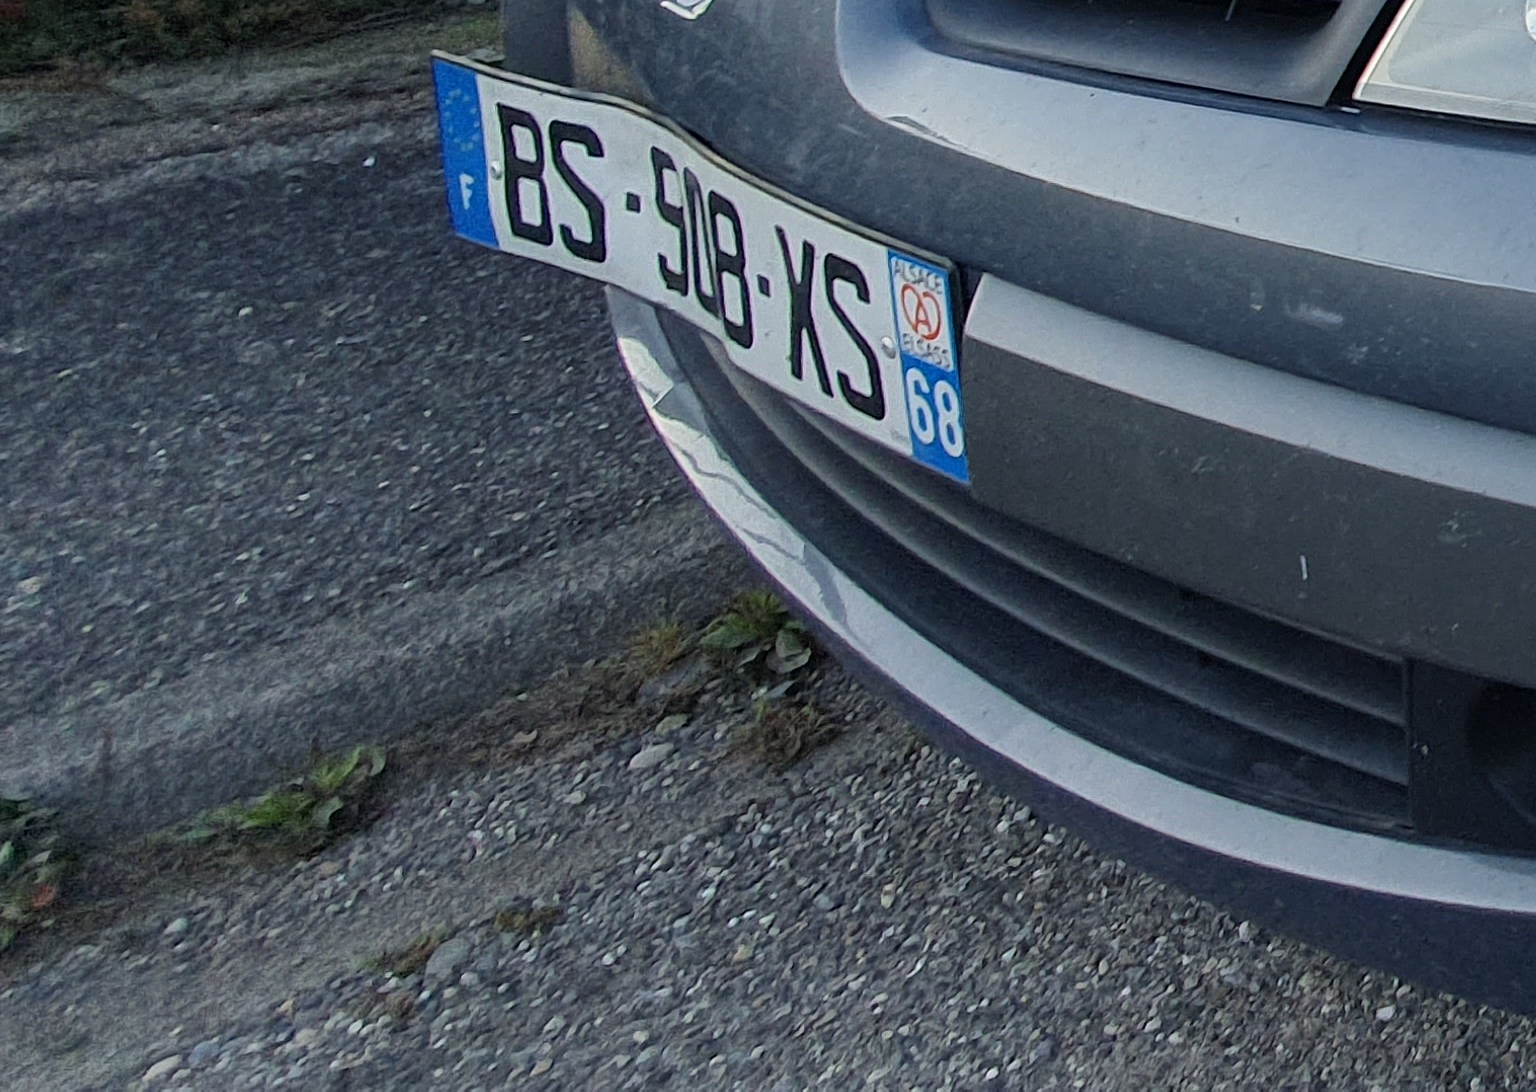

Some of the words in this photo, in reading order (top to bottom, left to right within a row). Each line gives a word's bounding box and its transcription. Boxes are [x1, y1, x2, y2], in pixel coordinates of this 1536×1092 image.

[458, 172, 475, 210] F
[893, 262, 943, 295] ALSACE
[906, 367, 965, 458] 68
